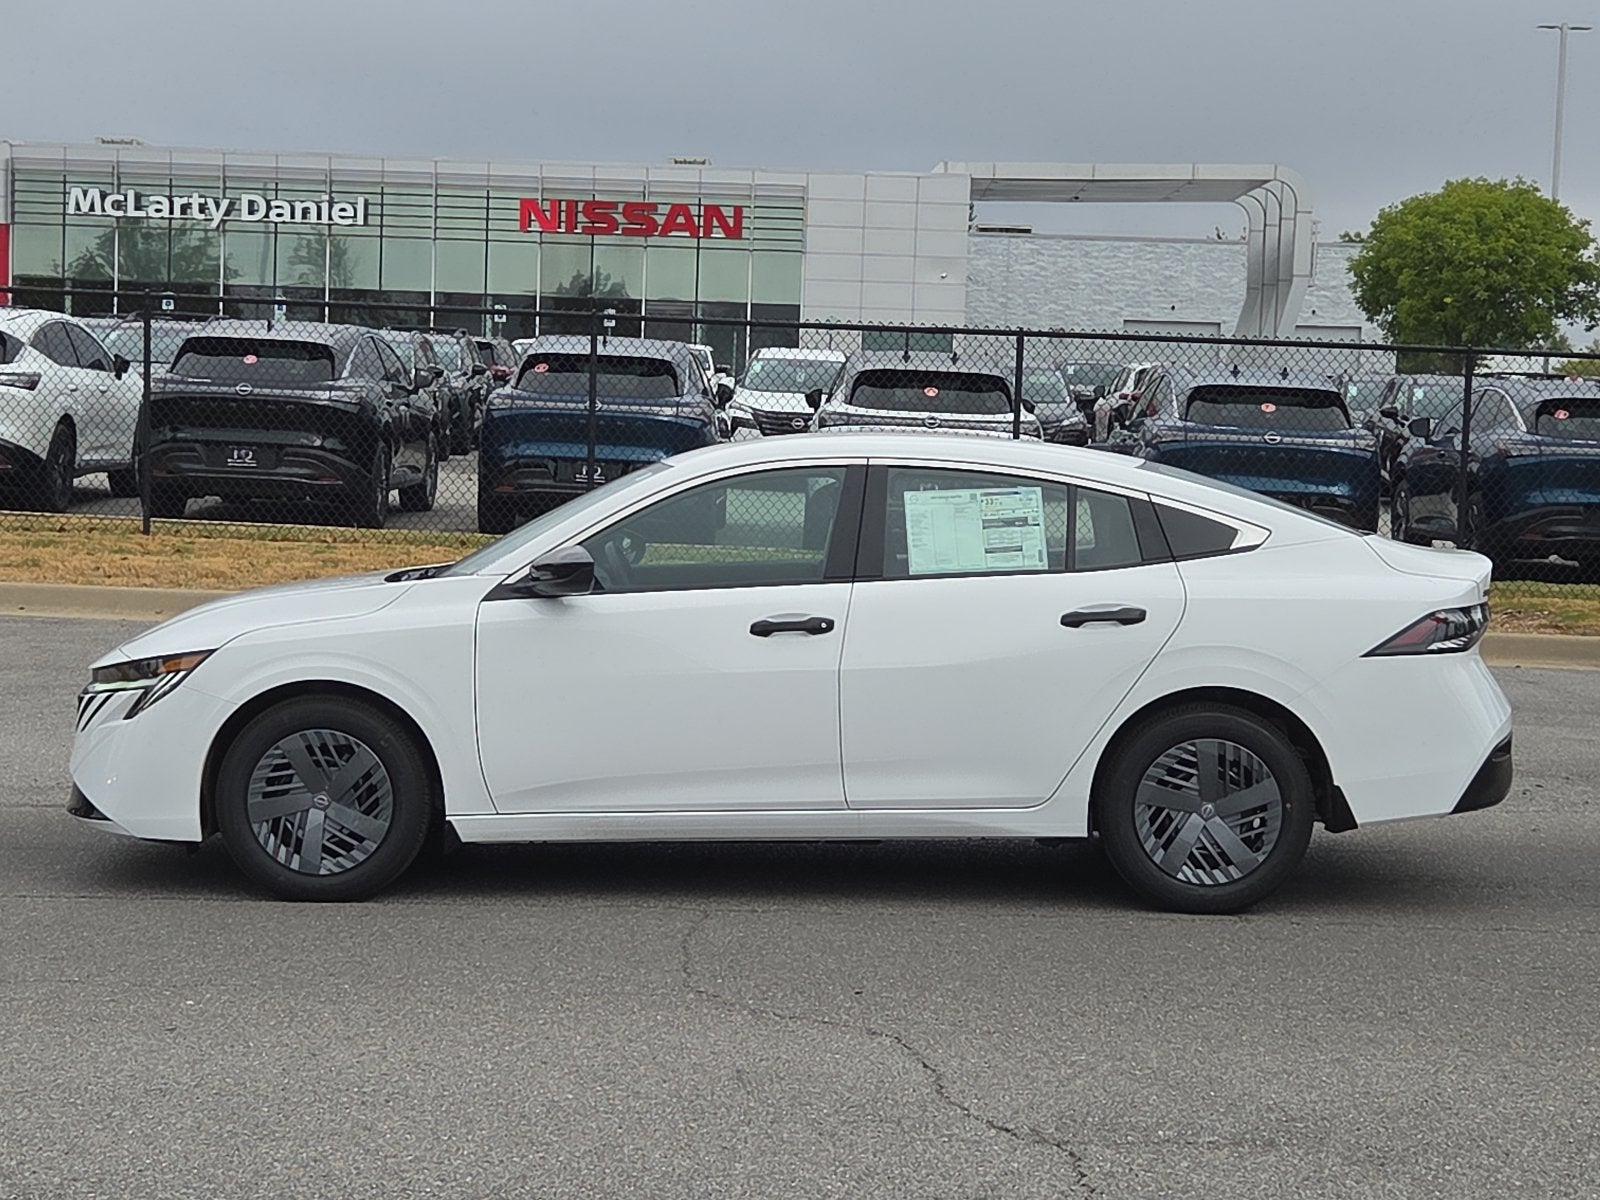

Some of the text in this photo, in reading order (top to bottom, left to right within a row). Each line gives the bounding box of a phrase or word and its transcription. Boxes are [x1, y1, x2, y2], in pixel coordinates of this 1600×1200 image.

[67, 186, 365, 229] McLarty Daniel
[519, 197, 743, 240] NISSAN
